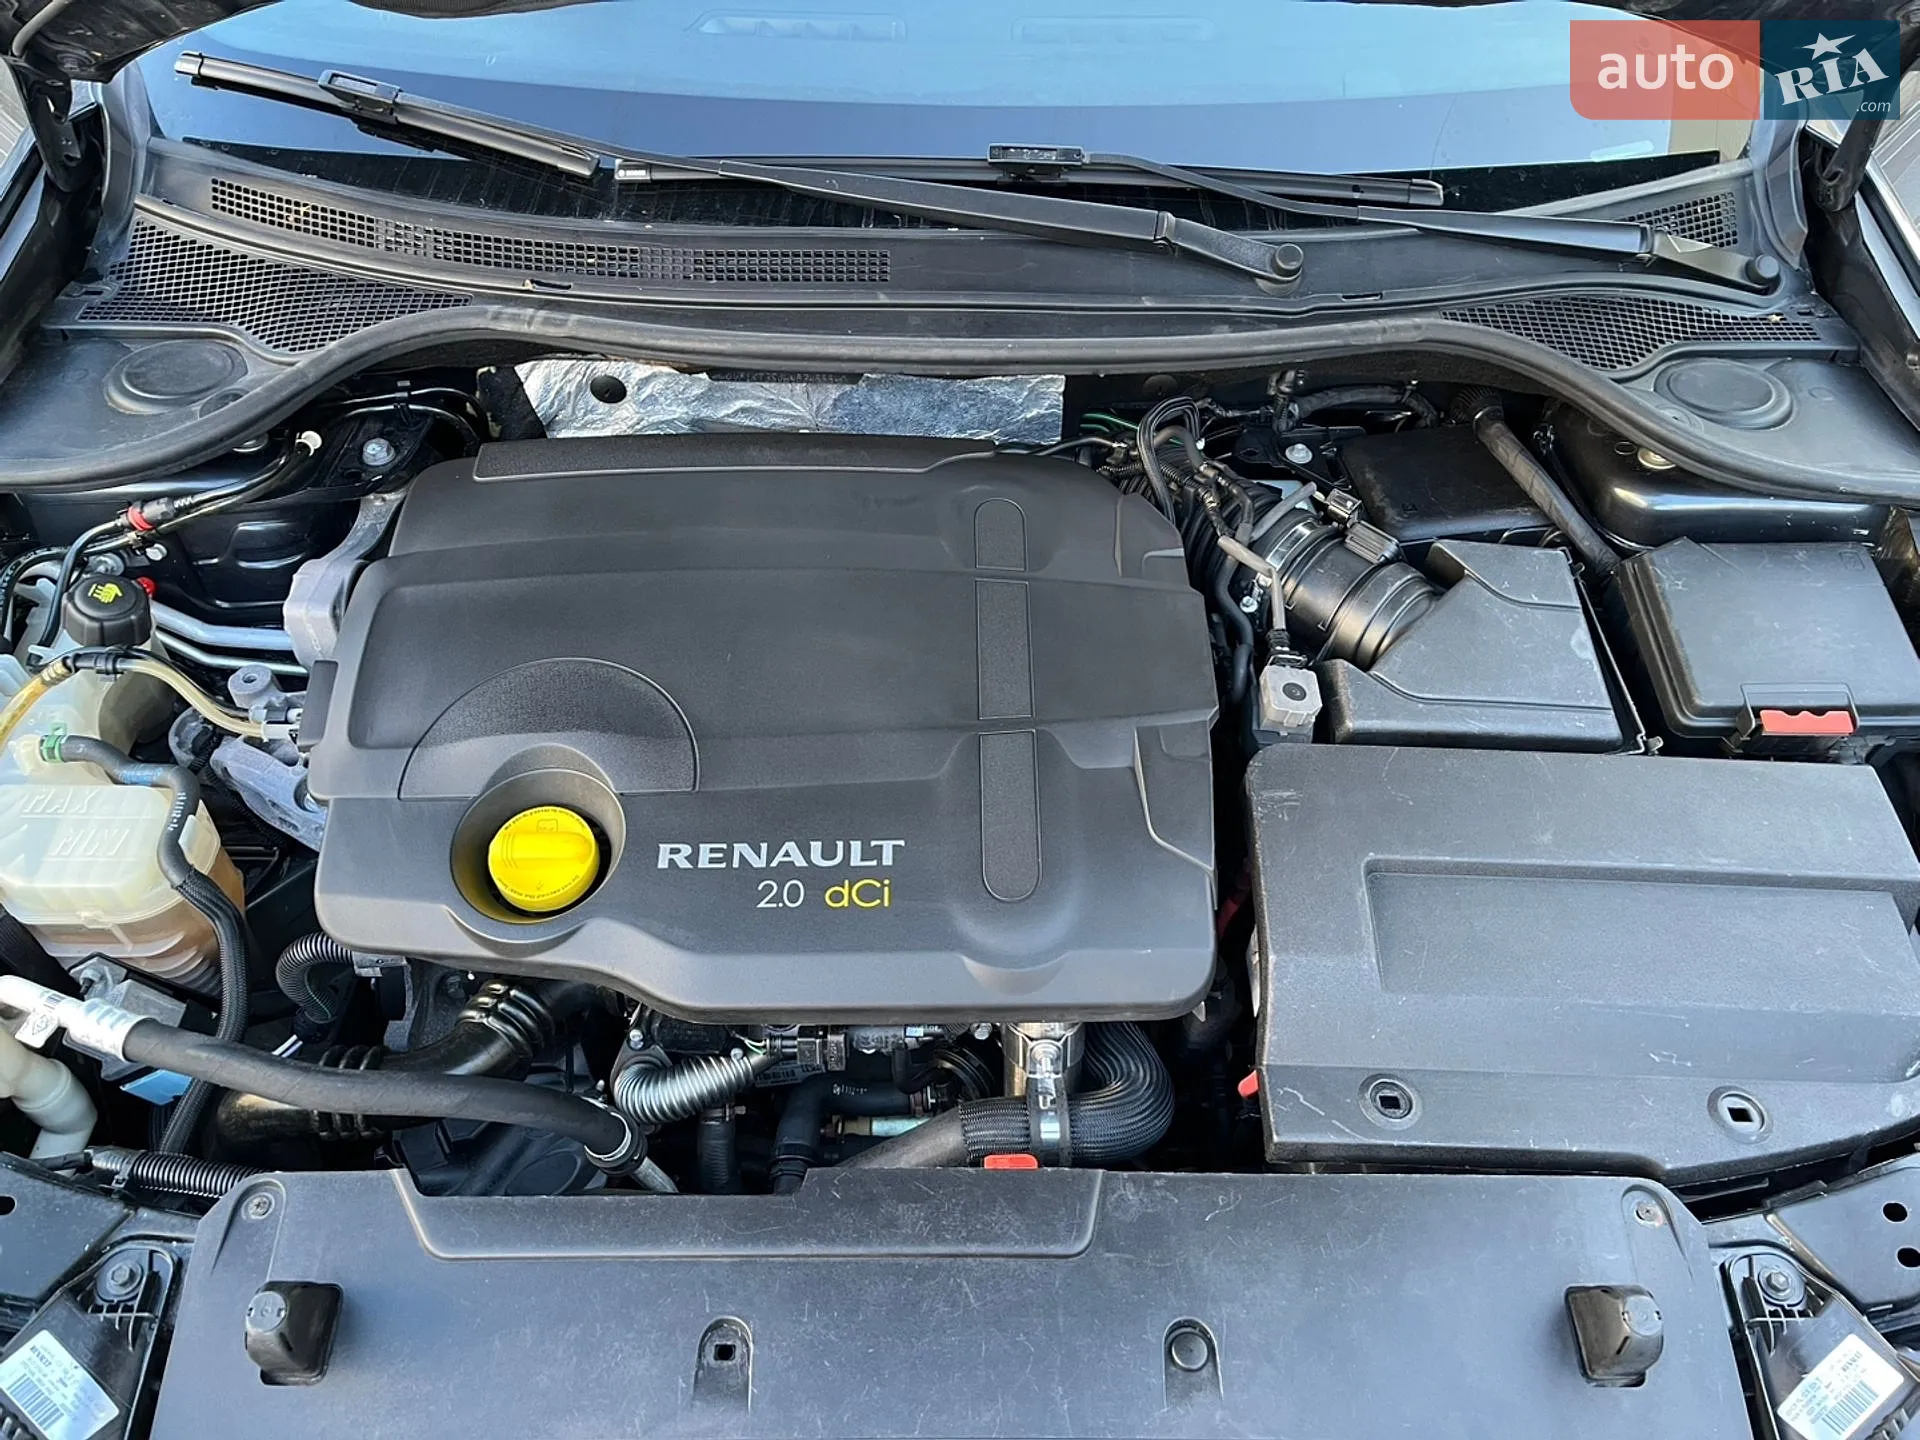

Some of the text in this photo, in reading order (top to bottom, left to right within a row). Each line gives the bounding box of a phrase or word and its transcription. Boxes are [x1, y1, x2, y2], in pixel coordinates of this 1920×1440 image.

[22, 787, 100, 813] MAX
[657, 840, 905, 869] RENAULT
[756, 878, 891, 908] 2.0 dCi
